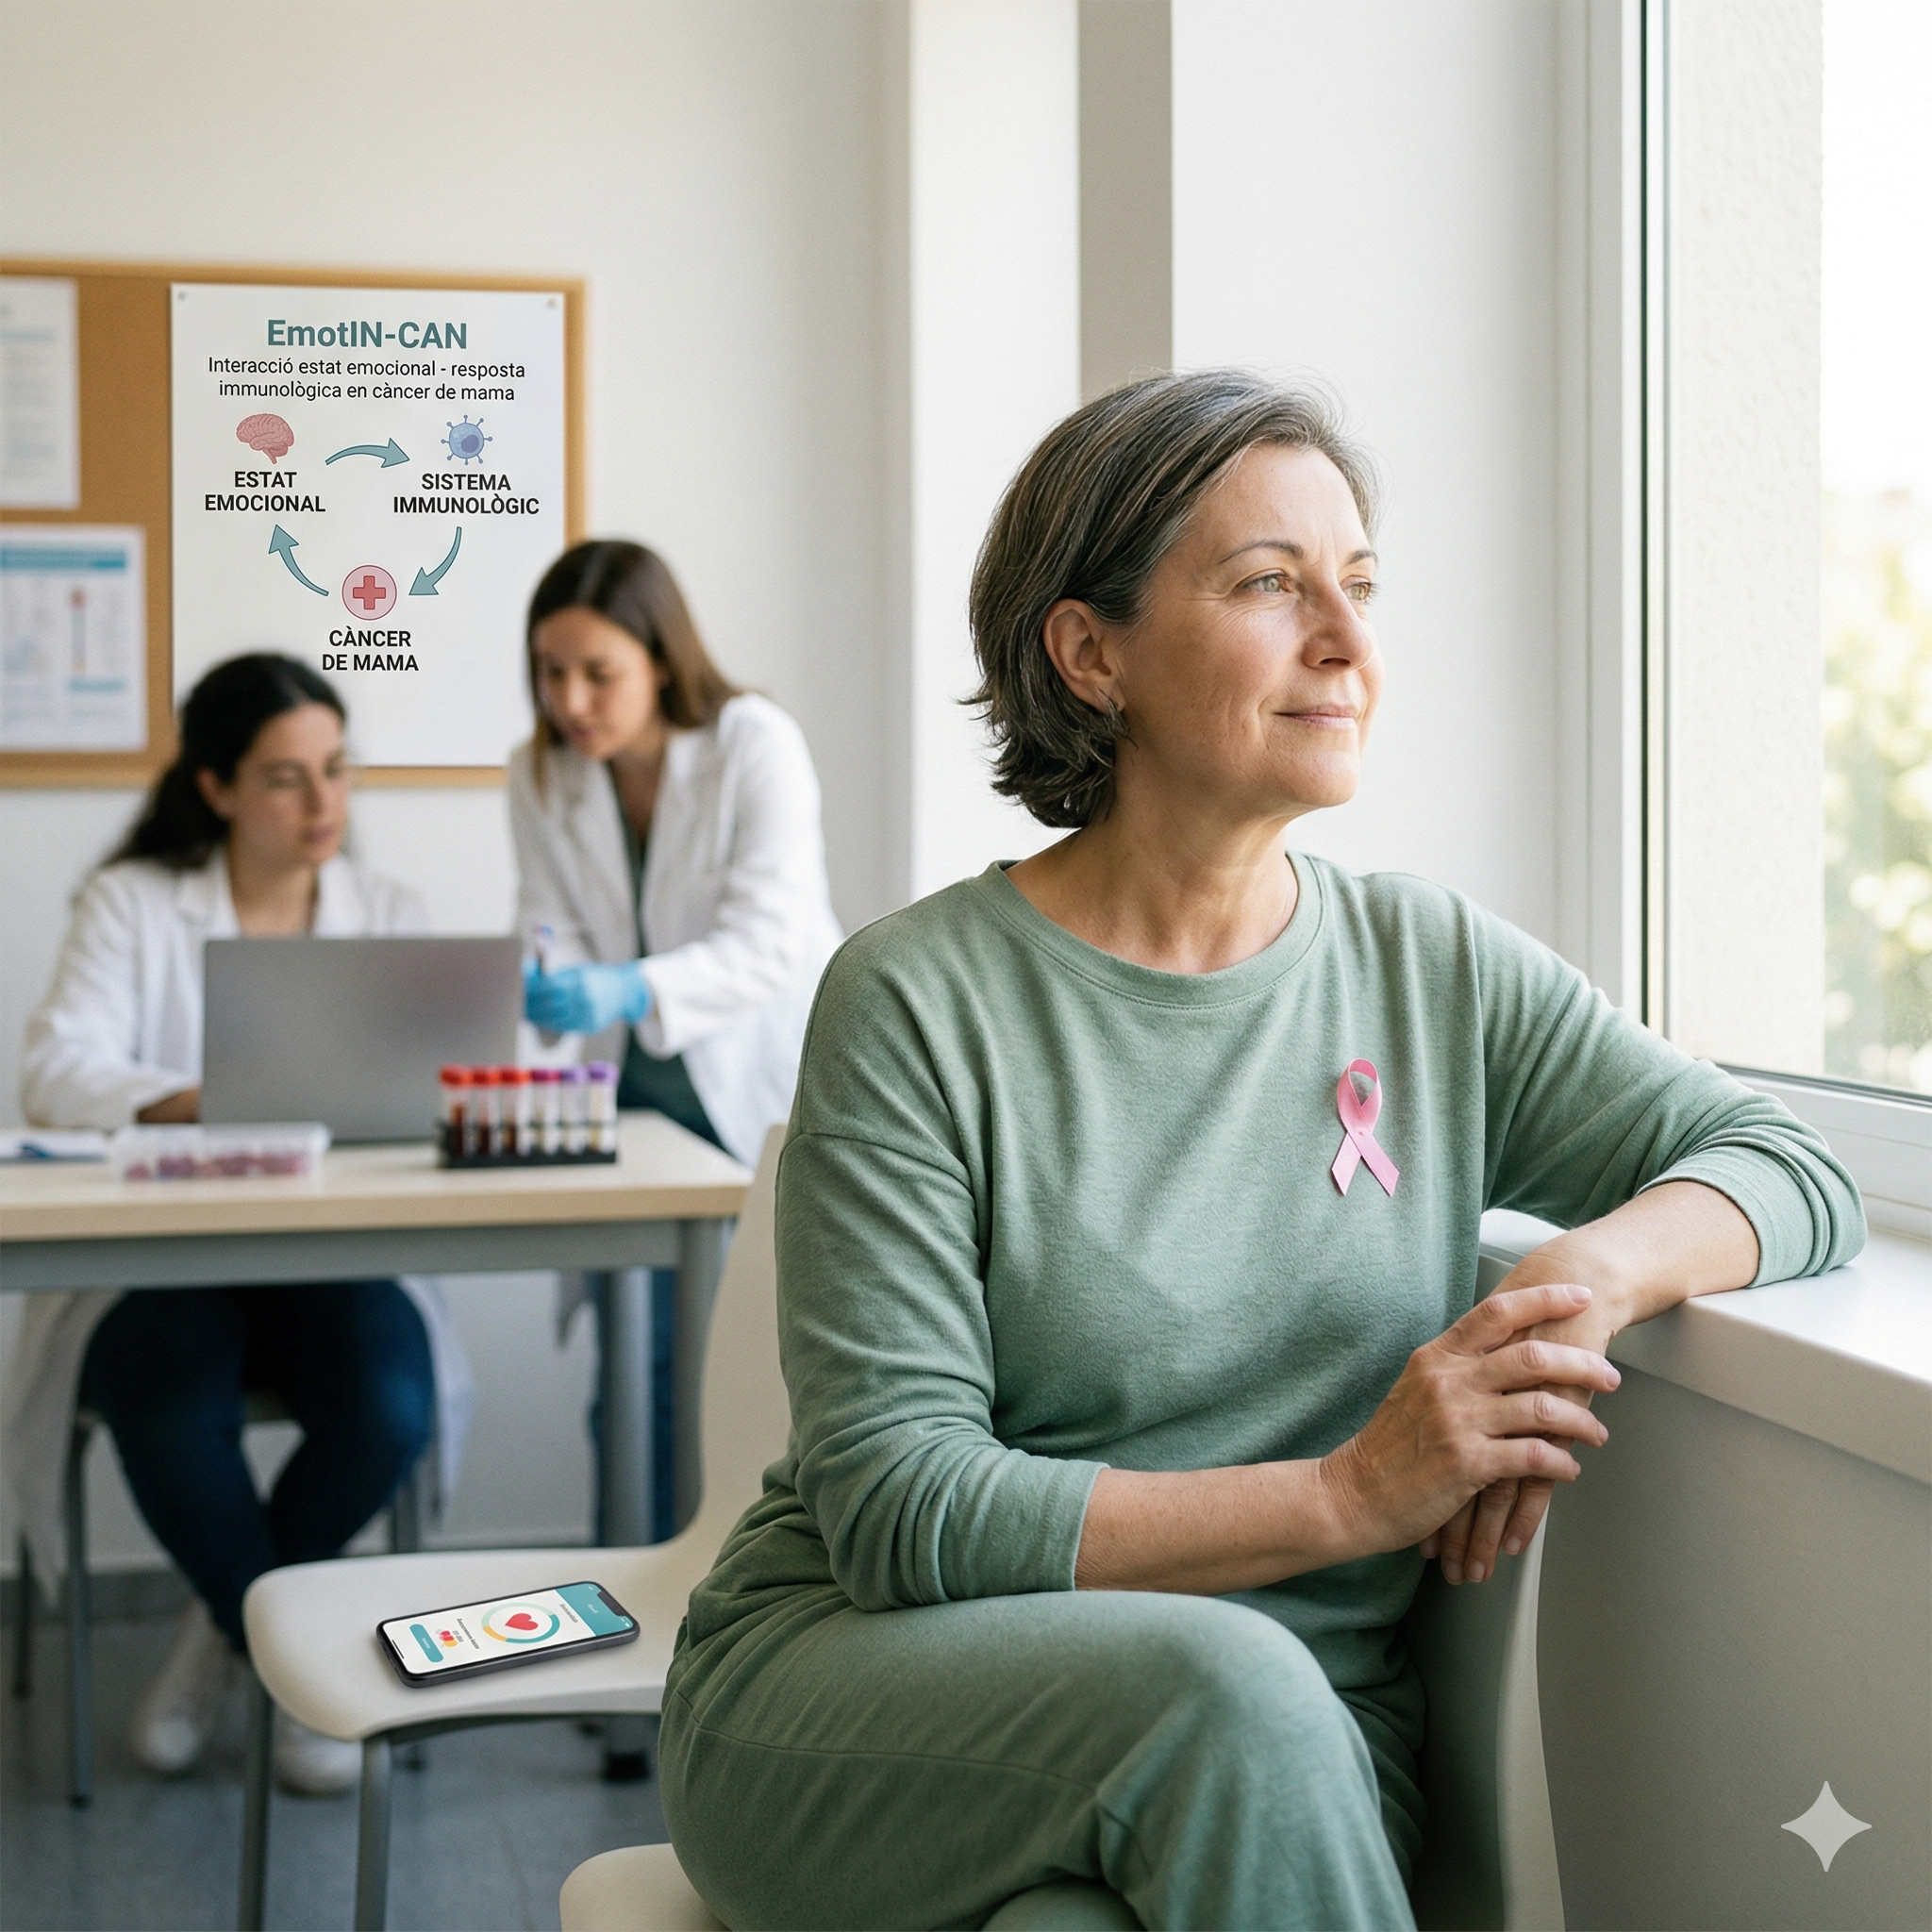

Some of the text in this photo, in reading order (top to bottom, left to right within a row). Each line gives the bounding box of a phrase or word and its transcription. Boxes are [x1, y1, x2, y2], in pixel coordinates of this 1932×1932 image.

[267, 319, 467, 350] EmotIN-CAN
[208, 356, 293, 375] Interacció
[298, 359, 342, 375] estat
[346, 359, 436, 376] emocional
[451, 362, 525, 381] resposta
[219, 379, 515, 402] immunològica en càncer de mama
[234, 470, 298, 489] ESTAT
[421, 473, 512, 491] SISTEMA
[205, 493, 326, 512] EMOCIONAL
[393, 493, 540, 515] IMMUNOLÒGIC
[328, 626, 412, 648] CÀNCER
[322, 653, 420, 672] DE MAMA
